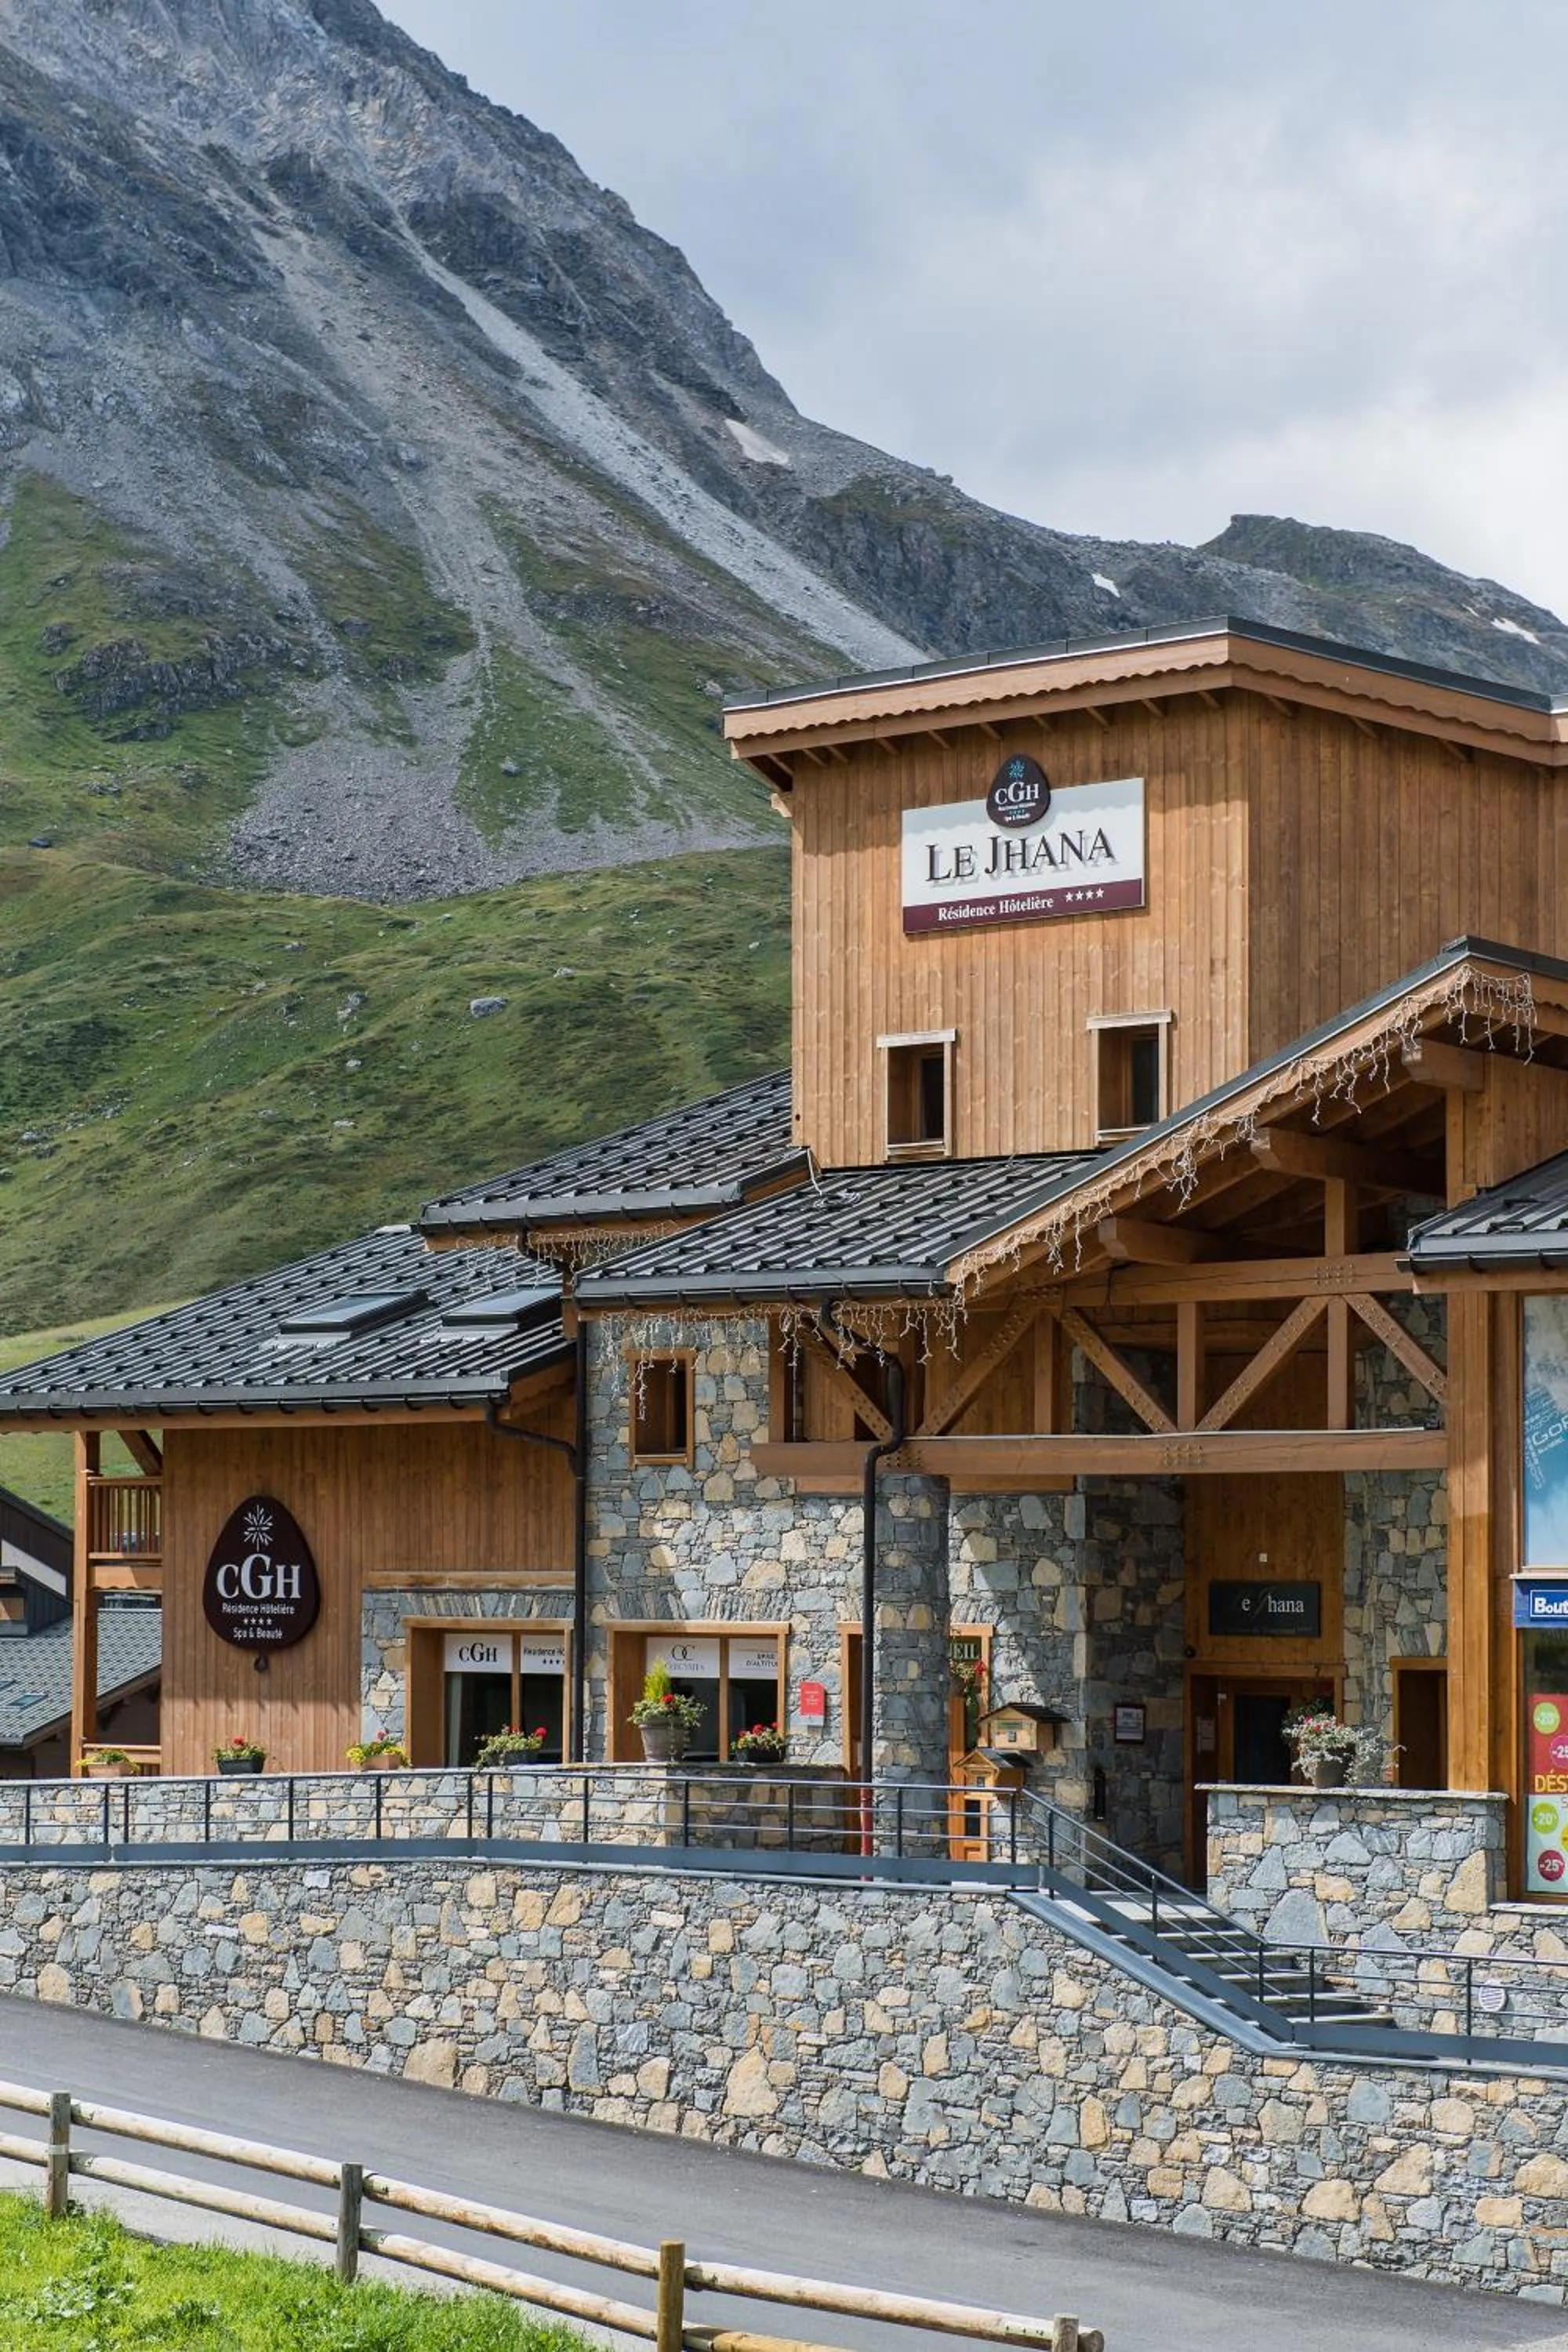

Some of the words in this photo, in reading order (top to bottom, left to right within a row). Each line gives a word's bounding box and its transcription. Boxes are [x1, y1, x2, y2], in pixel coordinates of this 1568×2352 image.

[994, 782, 1040, 805] CGH
[925, 843, 975, 882] LE
[984, 827, 1116, 875] JHANA
[938, 900, 996, 921] Résidence
[1000, 895, 1054, 915] Hôtelière
[216, 1553, 302, 1599] CGH
[222, 1602, 258, 1615] Résidence
[233, 1627, 248, 1641] Spa
[256, 1627, 283, 1639] Beauté
[459, 1642, 498, 1664] CGH
